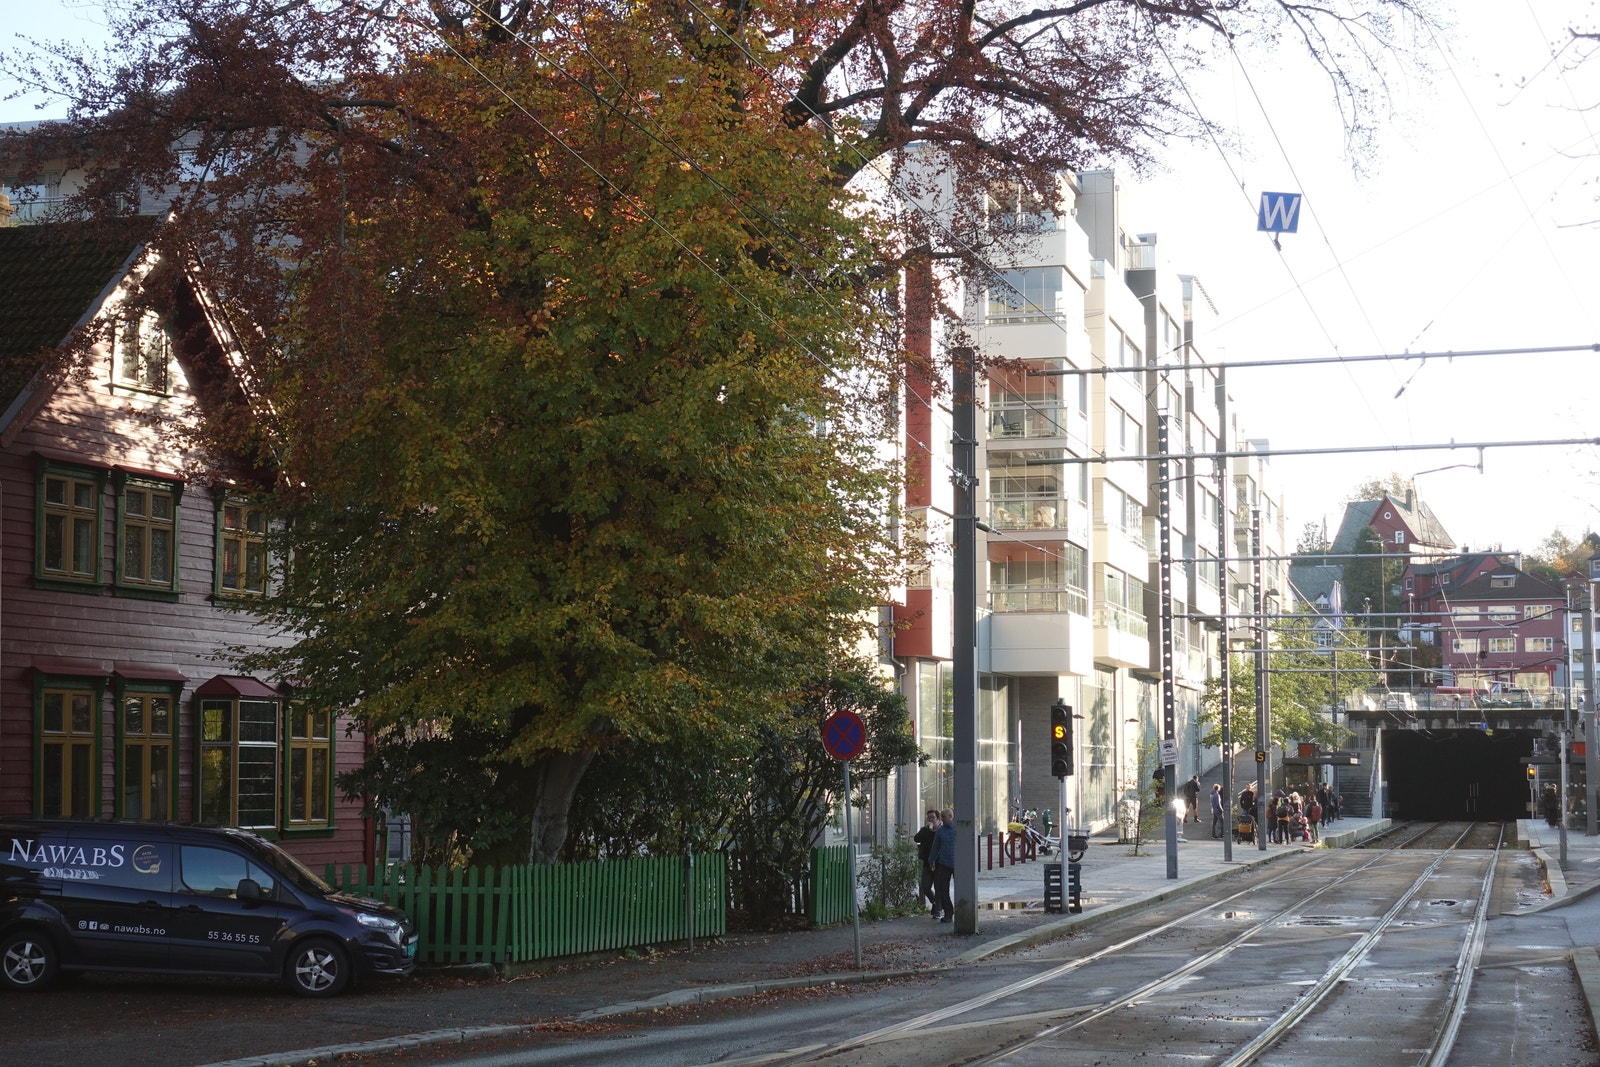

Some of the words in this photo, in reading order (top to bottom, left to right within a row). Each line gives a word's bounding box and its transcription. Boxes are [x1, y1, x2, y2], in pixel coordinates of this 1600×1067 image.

[1262, 195, 1300, 230] W
[1055, 726, 1064, 738] S
[1257, 752, 1264, 761] S
[8, 838, 125, 868] NAWABS
[114, 924, 166, 936] nawabs.no
[208, 931, 219, 940] 55
[221, 932, 233, 941] 36
[235, 933, 246, 942] 55
[248, 934, 260, 943] 55
